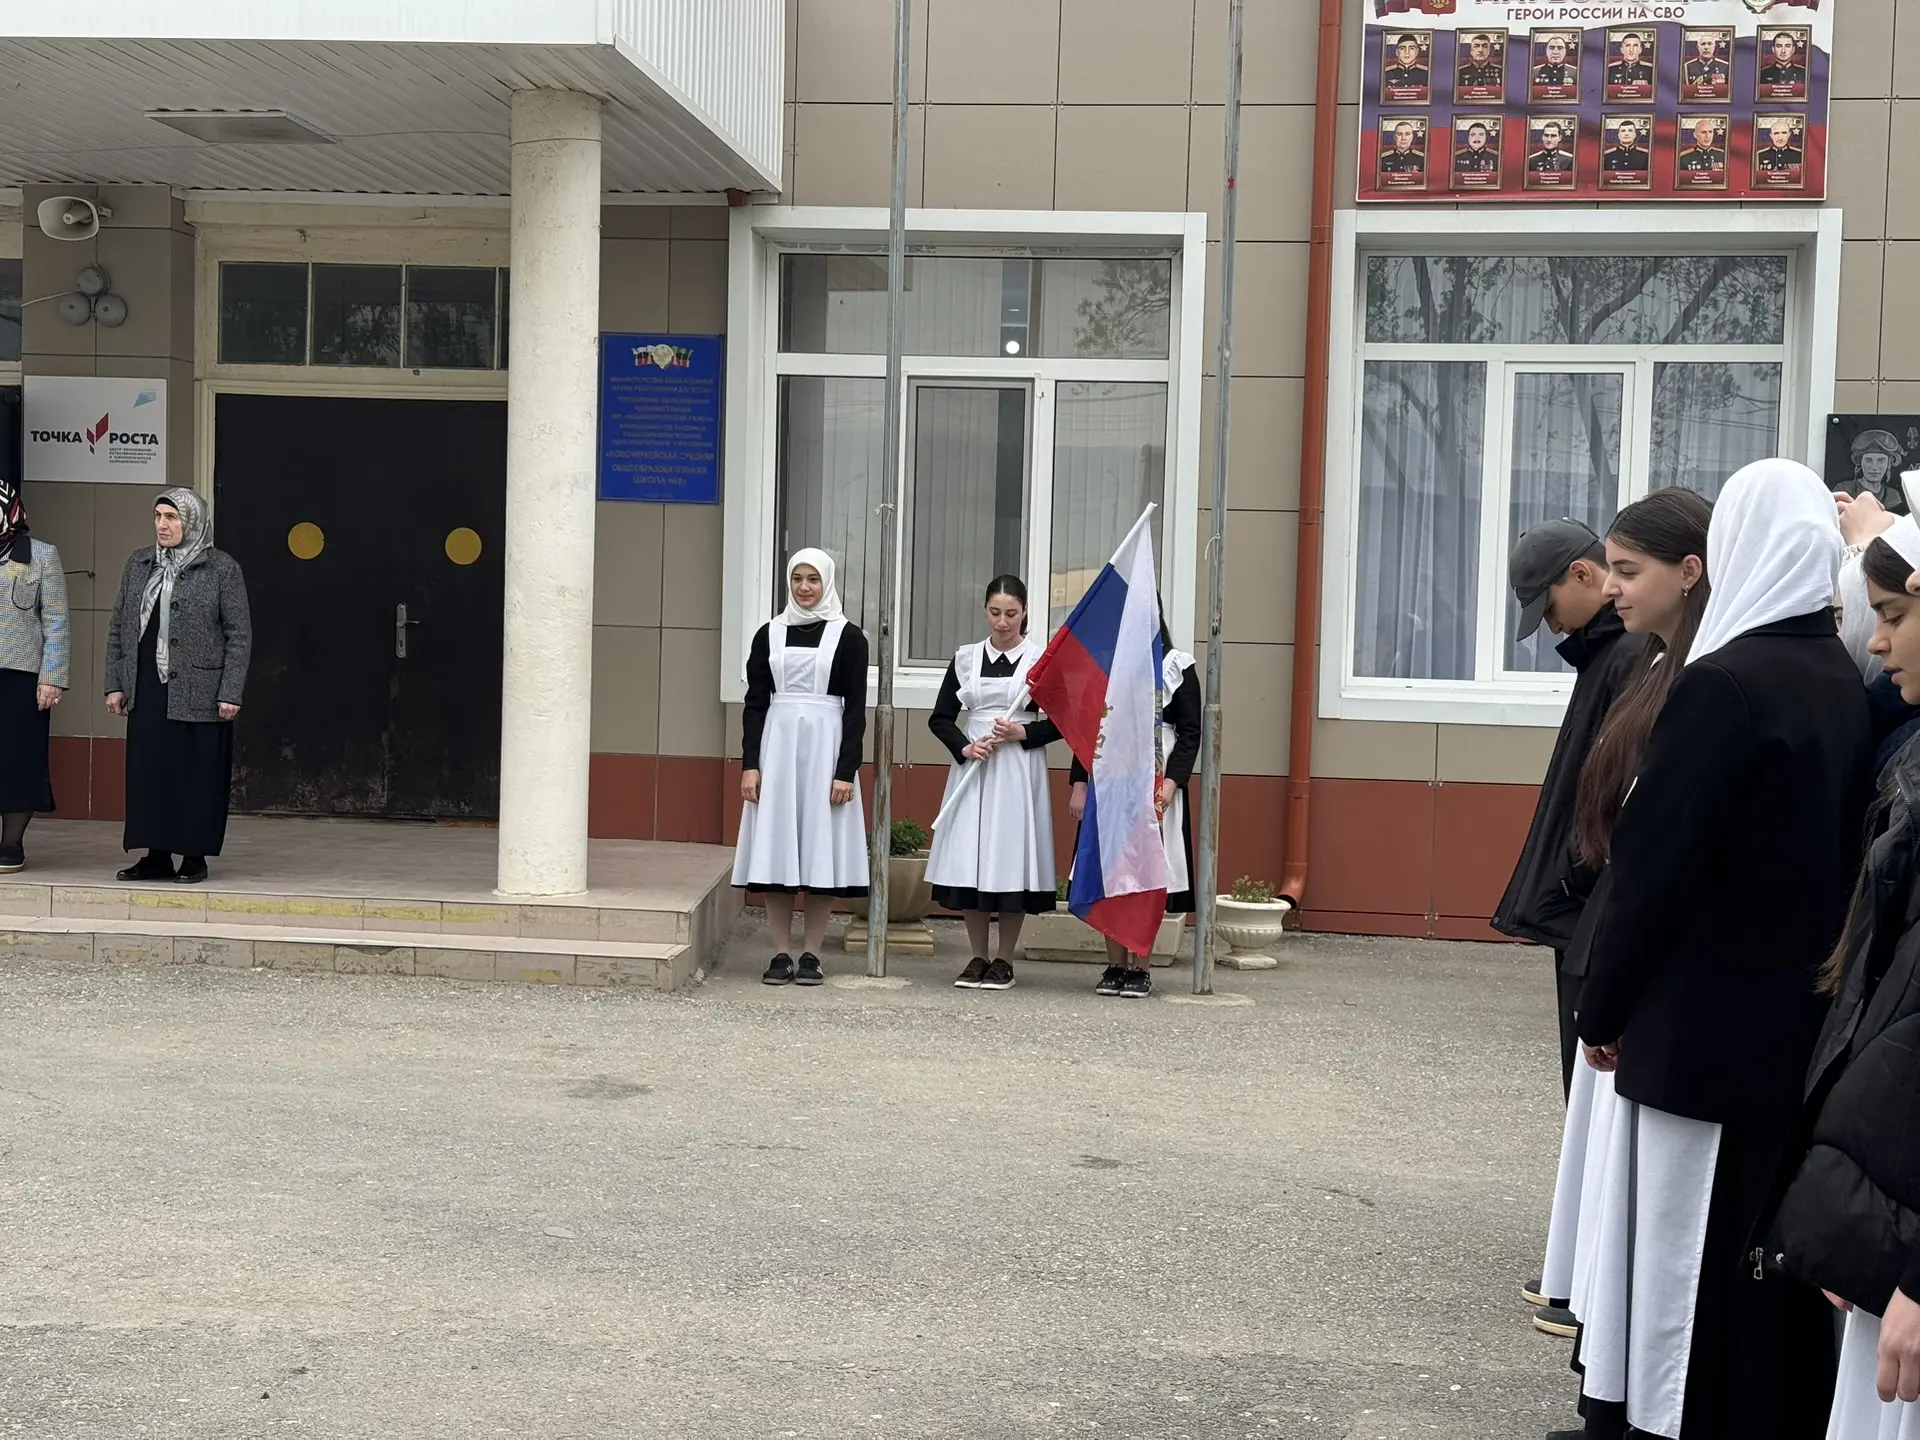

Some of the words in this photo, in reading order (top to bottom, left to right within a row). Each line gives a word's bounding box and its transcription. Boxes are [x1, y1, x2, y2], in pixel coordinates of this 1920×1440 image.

[1507, 8, 1554, 21] ГЕРОИ
[1559, 7, 1623, 20] РОССИИ
[1627, 7, 1648, 19] НА
[1653, 6, 1685, 19] СВО
[30, 430, 83, 444] ТОЧКА
[109, 432, 159, 445] РОСТА
